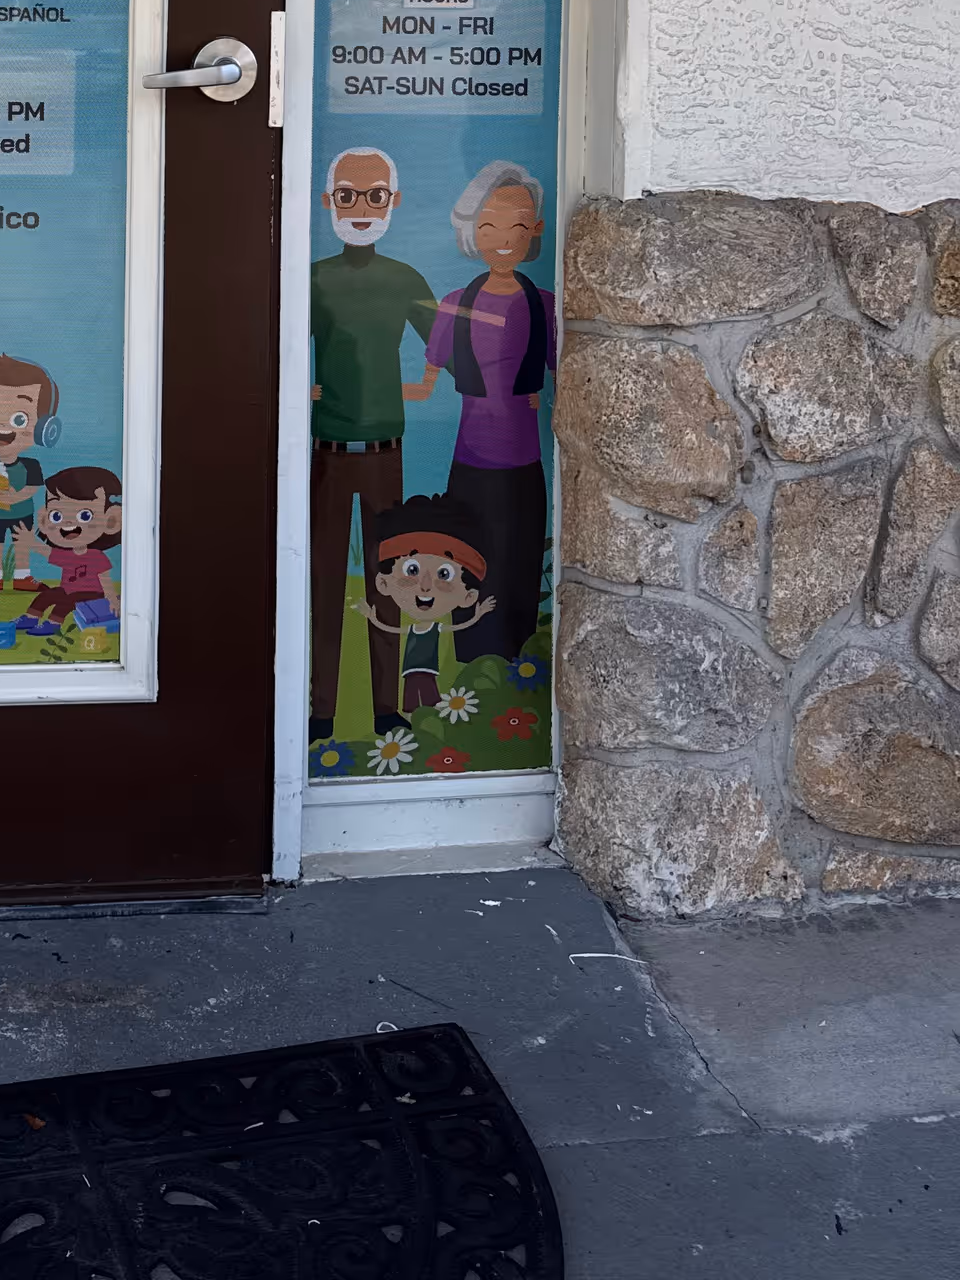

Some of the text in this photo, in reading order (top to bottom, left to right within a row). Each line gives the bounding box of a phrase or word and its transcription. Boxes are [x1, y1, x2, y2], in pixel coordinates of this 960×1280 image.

[382, 16, 435, 35] MON
[458, 16, 494, 35] FRI
[332, 45, 384, 65] 9:00
[391, 46, 426, 65] AM
[449, 47, 501, 66] 5:00
[508, 47, 542, 66] PM
[344, 76, 529, 96] SAT-SUN Closed
[8, 102, 45, 122] PM
